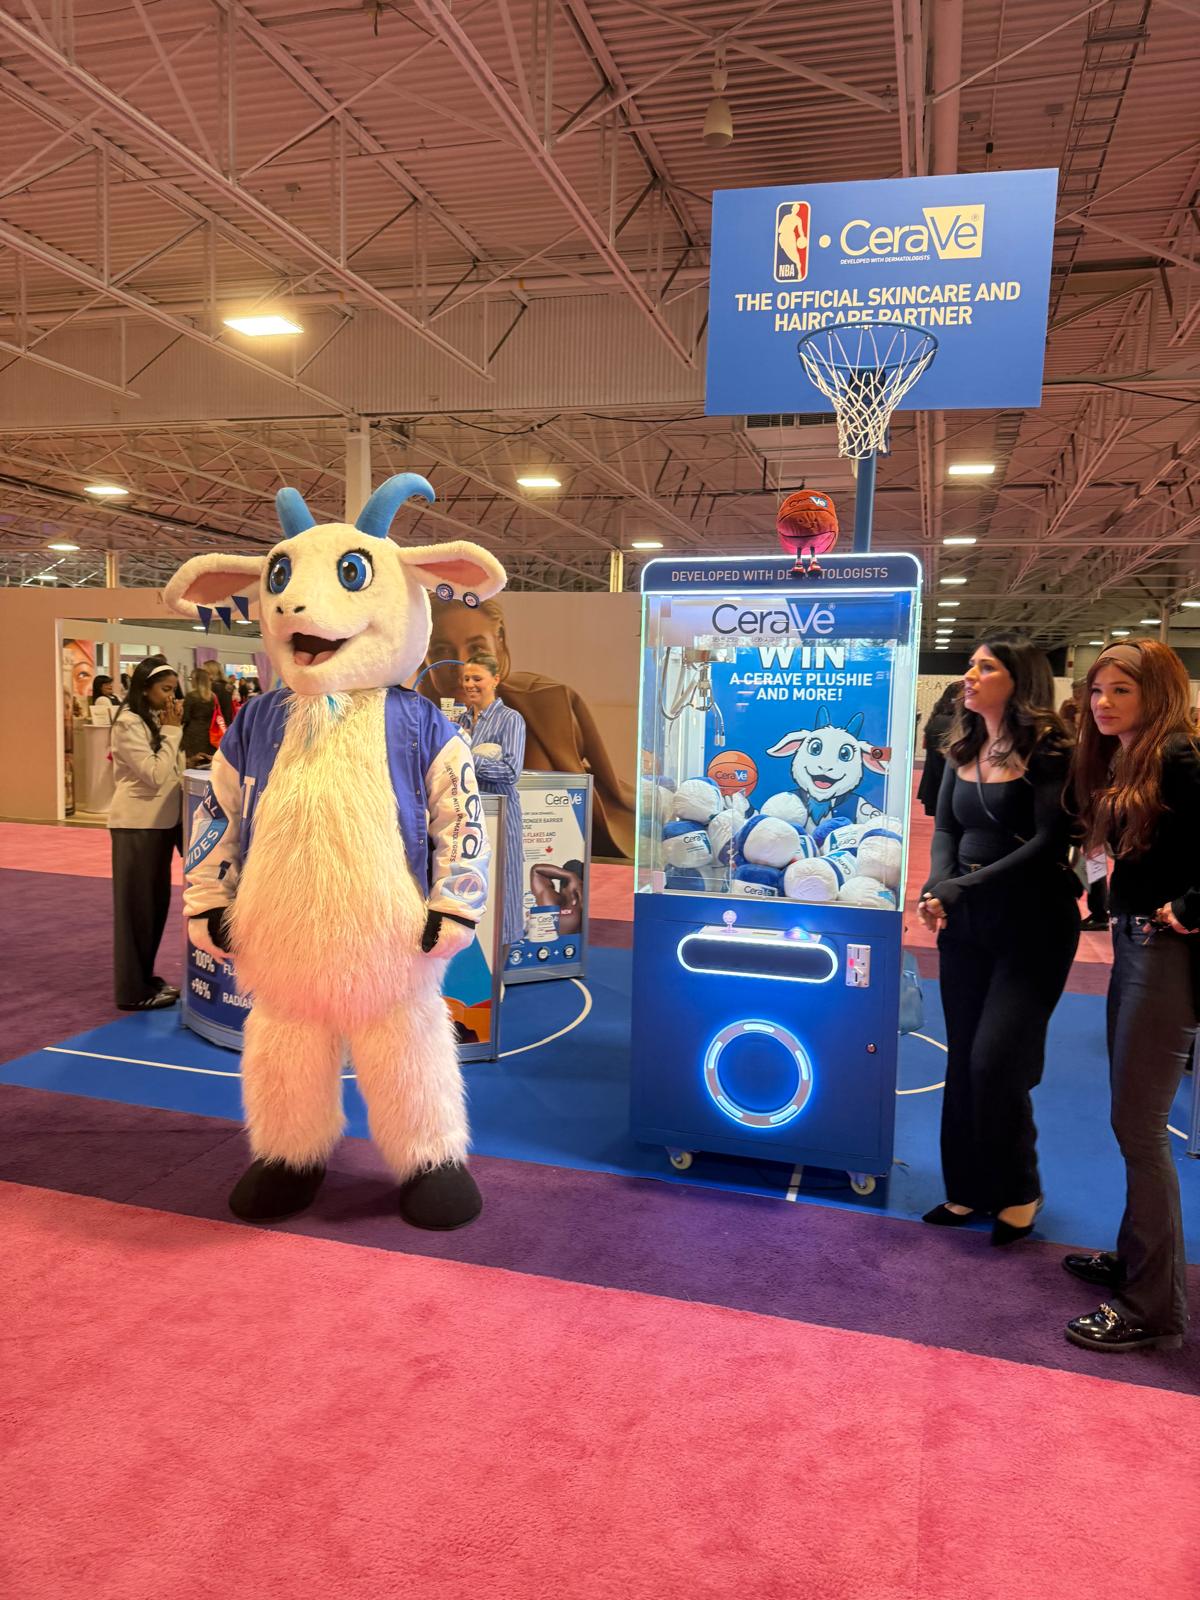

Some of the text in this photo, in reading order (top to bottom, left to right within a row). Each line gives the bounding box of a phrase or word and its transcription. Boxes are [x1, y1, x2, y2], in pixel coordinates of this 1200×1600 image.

[884, 255, 931, 263] DERMATOLOGISTS
[778, 264, 795, 277] NBA
[735, 281, 1021, 311] THE OFFICIAL SKINCARE AND
[774, 306, 973, 332] HAIRCARE PARTNER
[671, 567, 889, 582] DEVELOPED WITH DETOLOGISTS
[757, 646, 845, 670] WIN
[730, 672, 874, 686] A CERAVE PLUSHIE
[756, 687, 842, 701] AND MORE!
[715, 770, 748, 781] CeraVe
